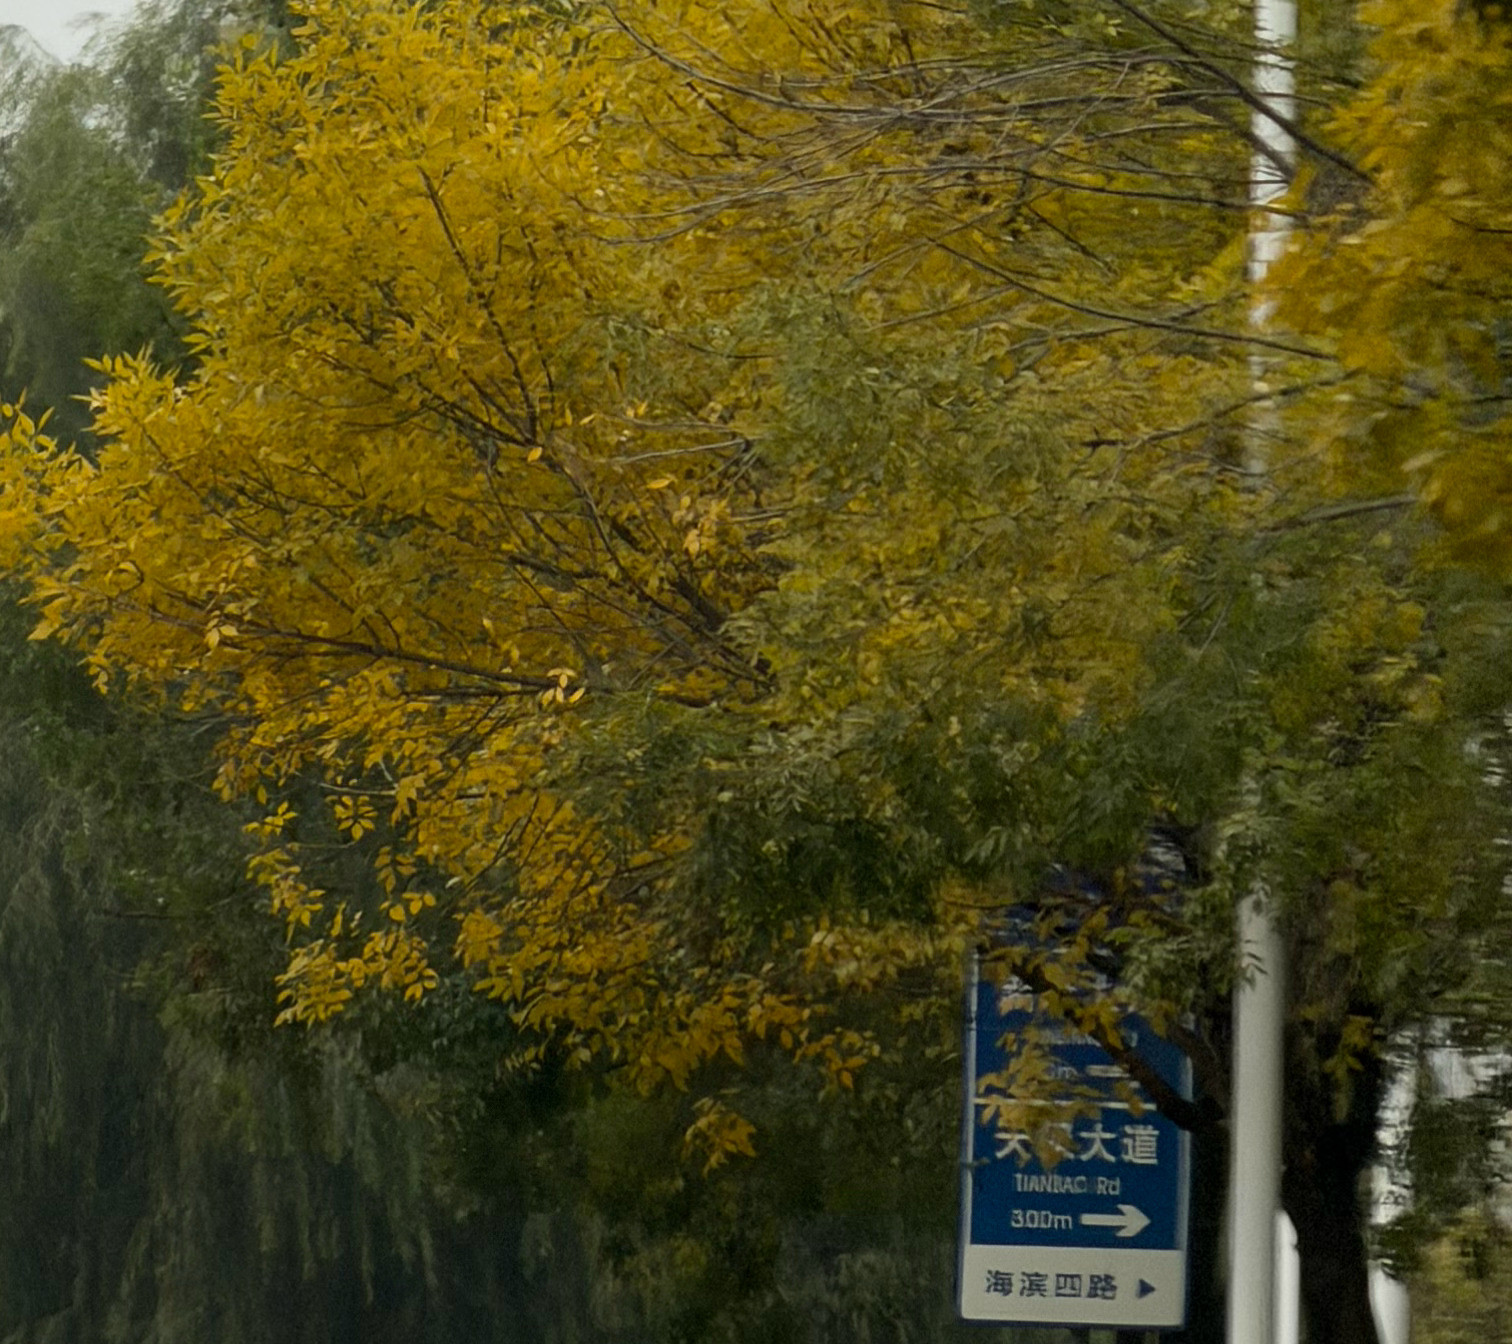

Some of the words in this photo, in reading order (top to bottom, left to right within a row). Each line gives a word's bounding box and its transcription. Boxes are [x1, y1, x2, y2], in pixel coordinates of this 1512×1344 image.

[994, 1122, 1160, 1165] 天大道
[1096, 1176, 1120, 1196] Rd
[1011, 1209, 1073, 1230] 300m
[985, 1269, 1117, 1300] 海滨四路
